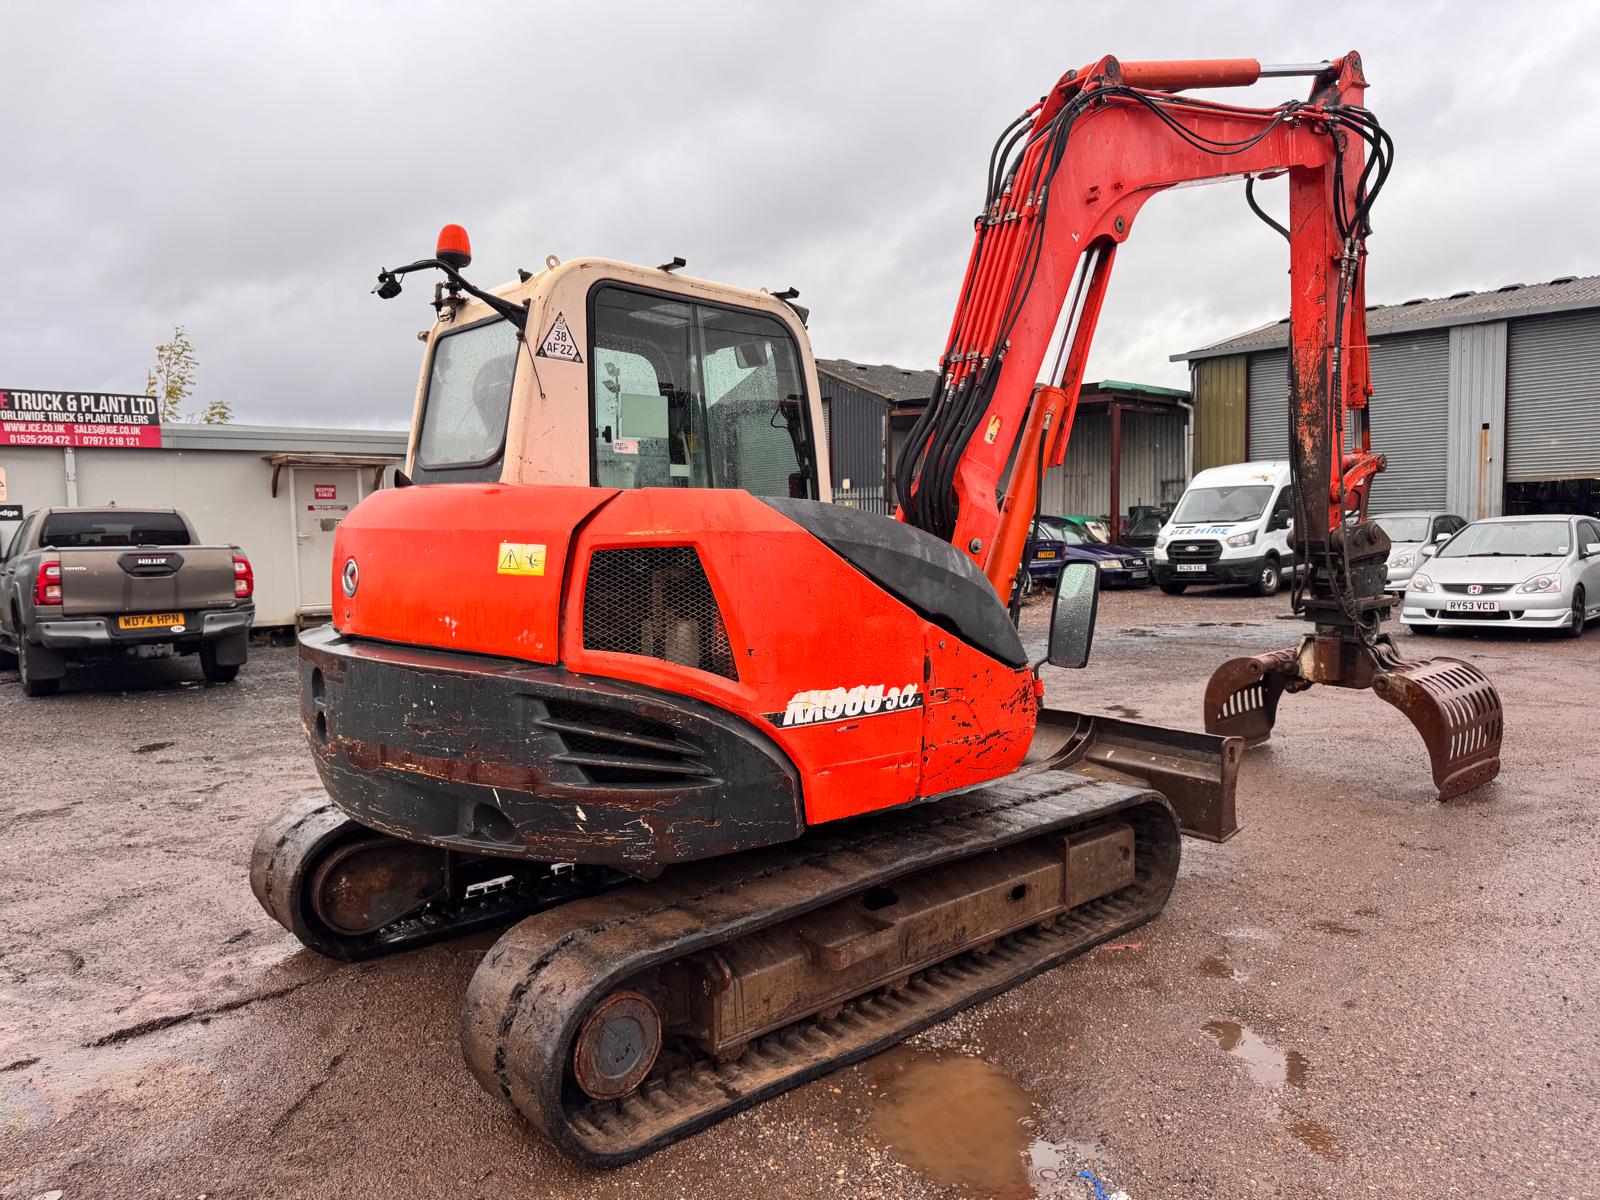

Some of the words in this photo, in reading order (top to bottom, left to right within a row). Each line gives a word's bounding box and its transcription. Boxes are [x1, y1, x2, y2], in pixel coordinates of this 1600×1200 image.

[554, 330, 567, 342] 38
[11, 392, 63, 411] TRUCK
[66, 395, 78, 412] &
[80, 395, 127, 413] PLANT
[130, 397, 156, 415] LTD
[0, 410, 46, 421] ORLDWIDE
[47, 412, 76, 422] TRUCK
[77, 413, 84, 423] &
[85, 413, 112, 424] PLANT
[113, 414, 149, 425] DEALERS
[10, 434, 36, 444] 01525
[37, 435, 53, 444] 229
[55, 436, 70, 445] 472
[83, 436, 107, 445] 07971
[109, 437, 124, 446] 218
[126, 437, 139, 446] 121
[1450, 602, 1474, 611] RY53
[1477, 602, 1495, 611] VCD
[124, 617, 154, 627] WD74
[157, 614, 180, 625] HPN
